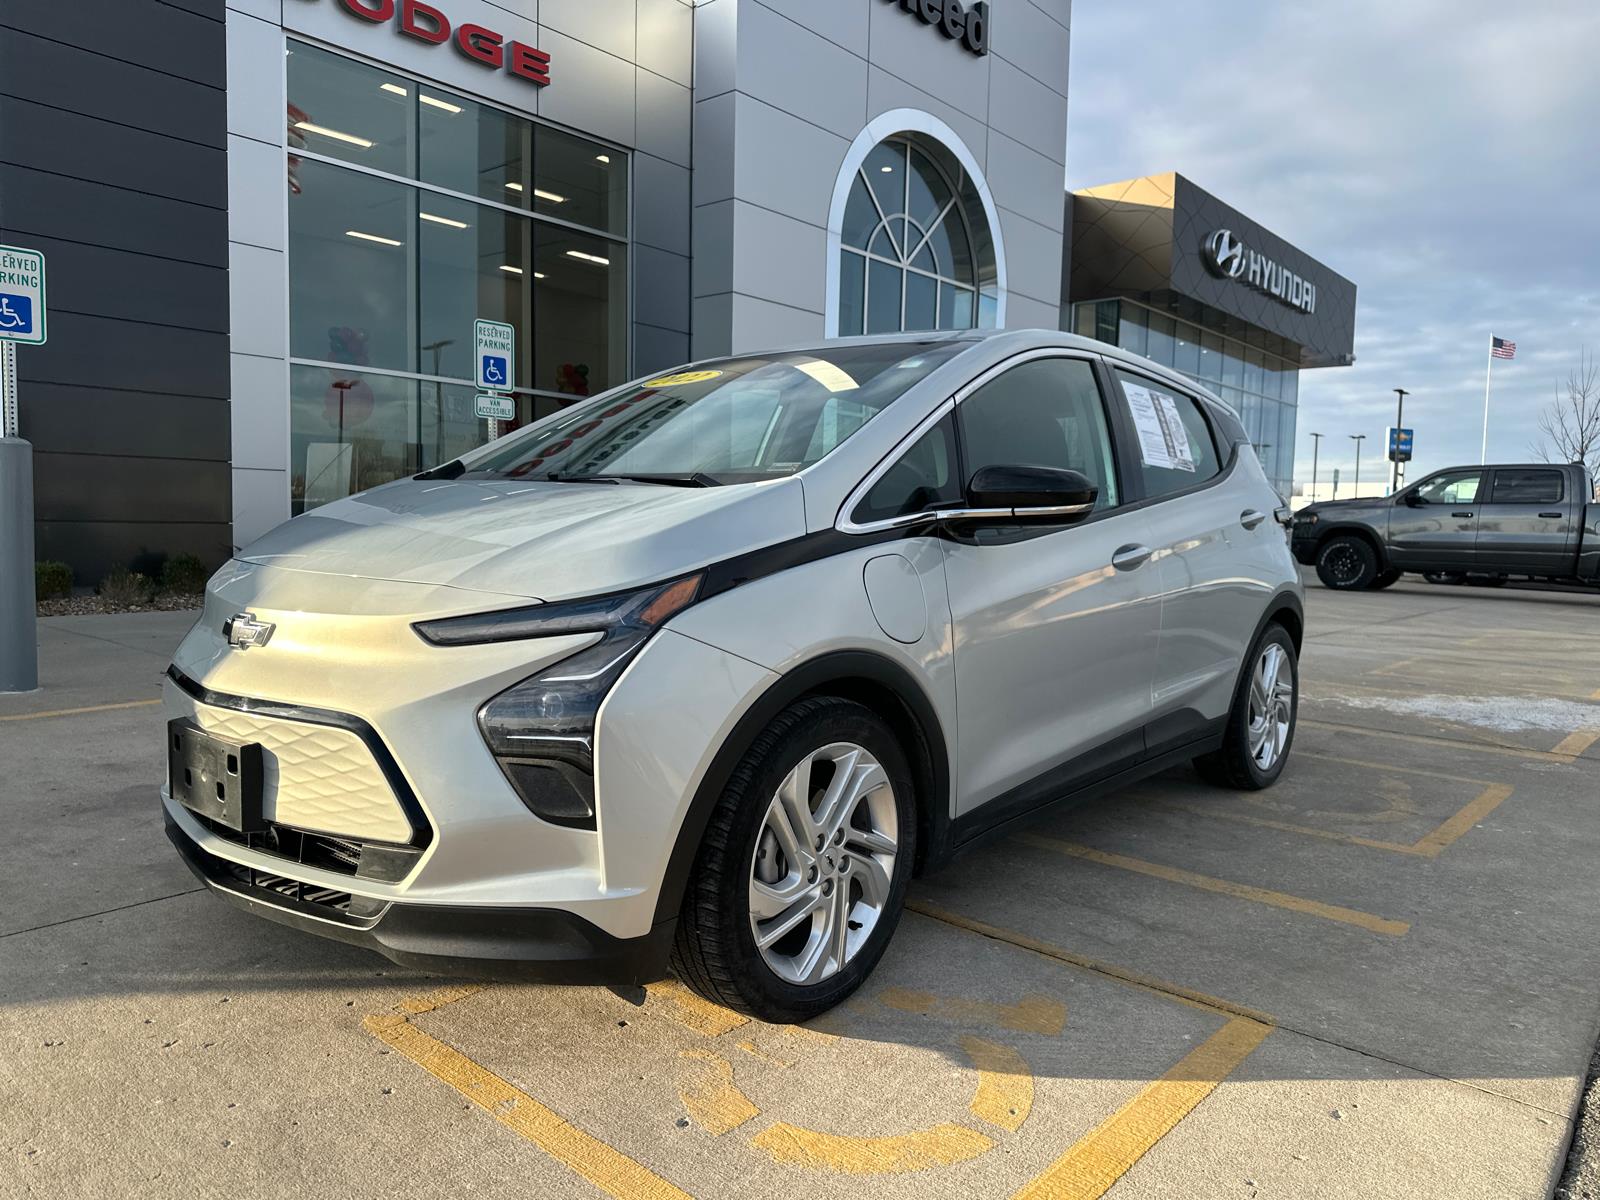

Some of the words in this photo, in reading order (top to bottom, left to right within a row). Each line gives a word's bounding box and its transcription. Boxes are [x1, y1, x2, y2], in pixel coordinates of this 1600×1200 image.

[900, 0, 989, 57] eed
[339, 0, 551, 88] DGE
[0, 256, 37, 272] ERVED
[1249, 250, 1317, 314] HYUNDAI
[479, 326, 510, 340] RESERVED
[479, 338, 511, 352] PARKING
[479, 406, 511, 416] ACCESSIBLE
[489, 399, 501, 408] VAN
